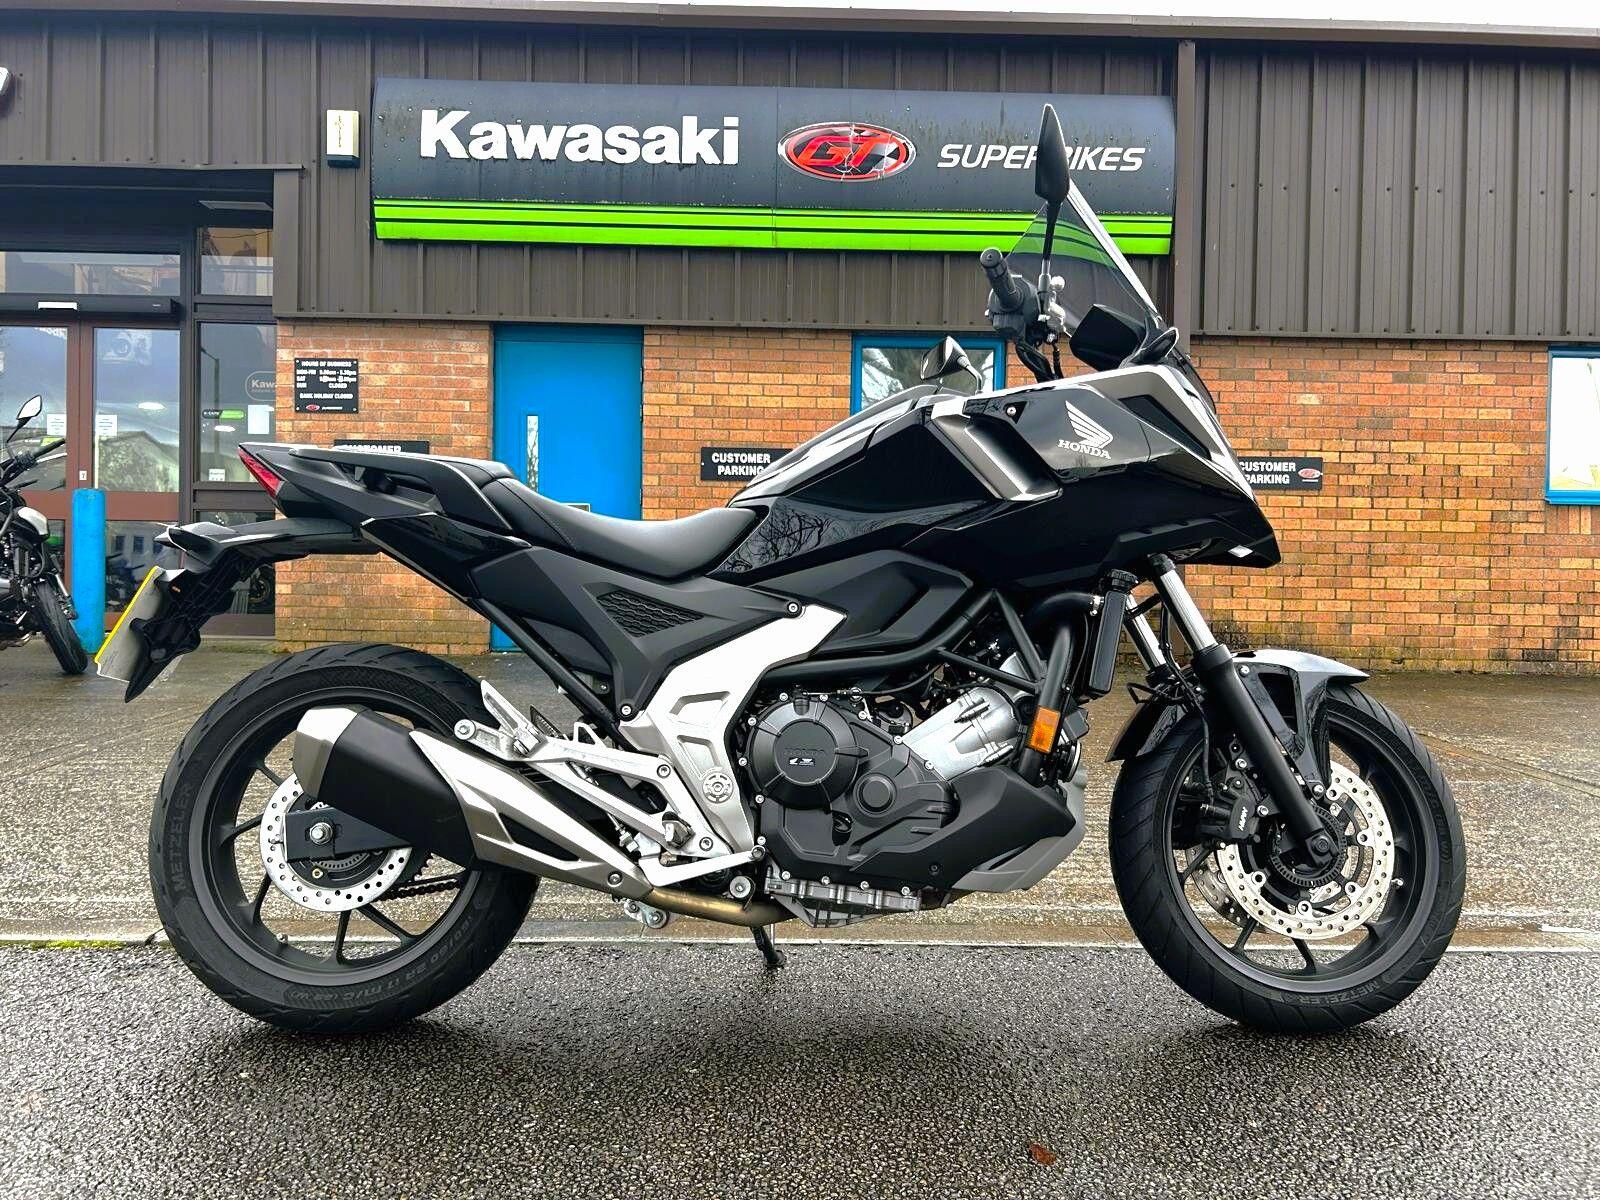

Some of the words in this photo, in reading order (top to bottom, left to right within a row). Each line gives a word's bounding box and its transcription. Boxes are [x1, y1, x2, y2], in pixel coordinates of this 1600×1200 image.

[420, 109, 739, 165] Kawasaki
[797, 135, 893, 167] GT
[711, 453, 770, 463] CUSTOMER
[1057, 439, 1111, 460] HONDA
[1239, 461, 1296, 472] CUSTOMER
